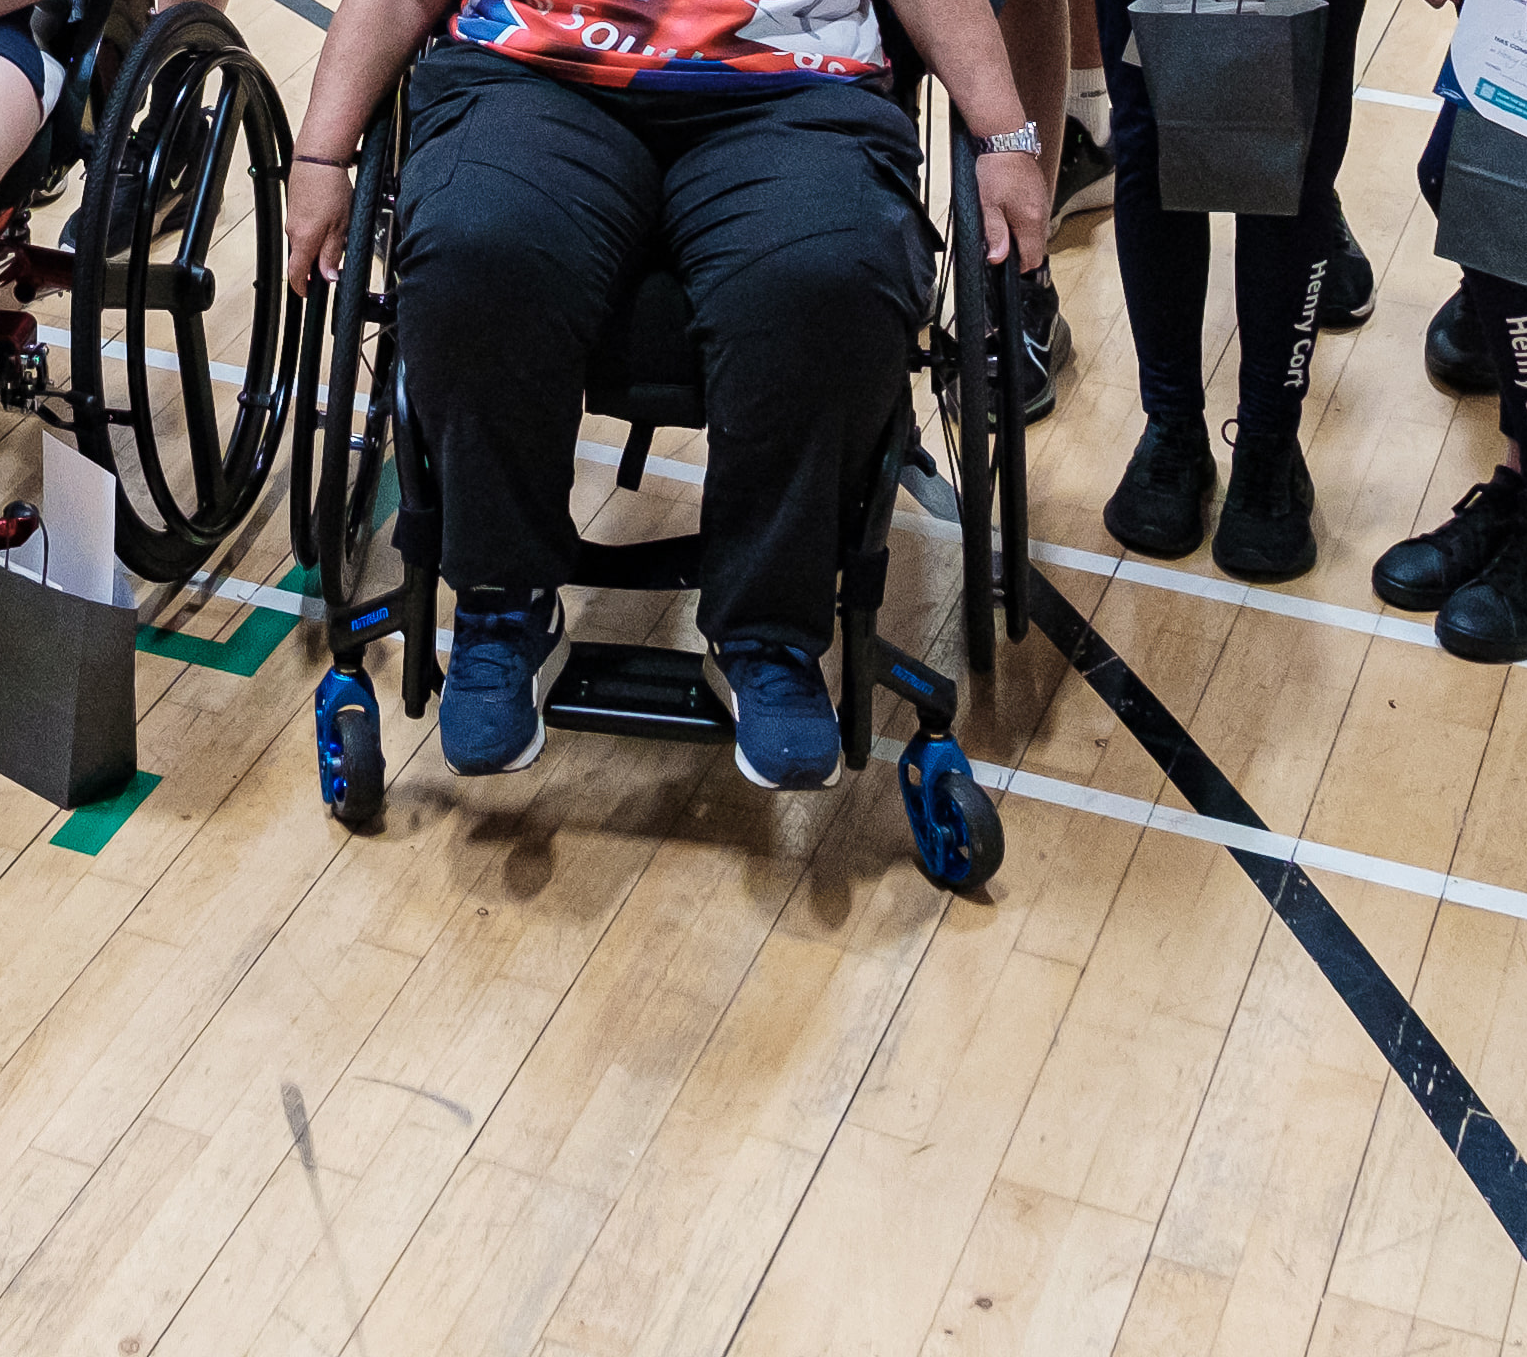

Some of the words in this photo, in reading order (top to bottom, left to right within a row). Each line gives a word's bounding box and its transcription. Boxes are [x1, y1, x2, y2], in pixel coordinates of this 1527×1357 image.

[1493, 35, 1509, 47] HAS
[1293, 258, 1328, 333] Henry
[1283, 337, 1312, 389] Cort
